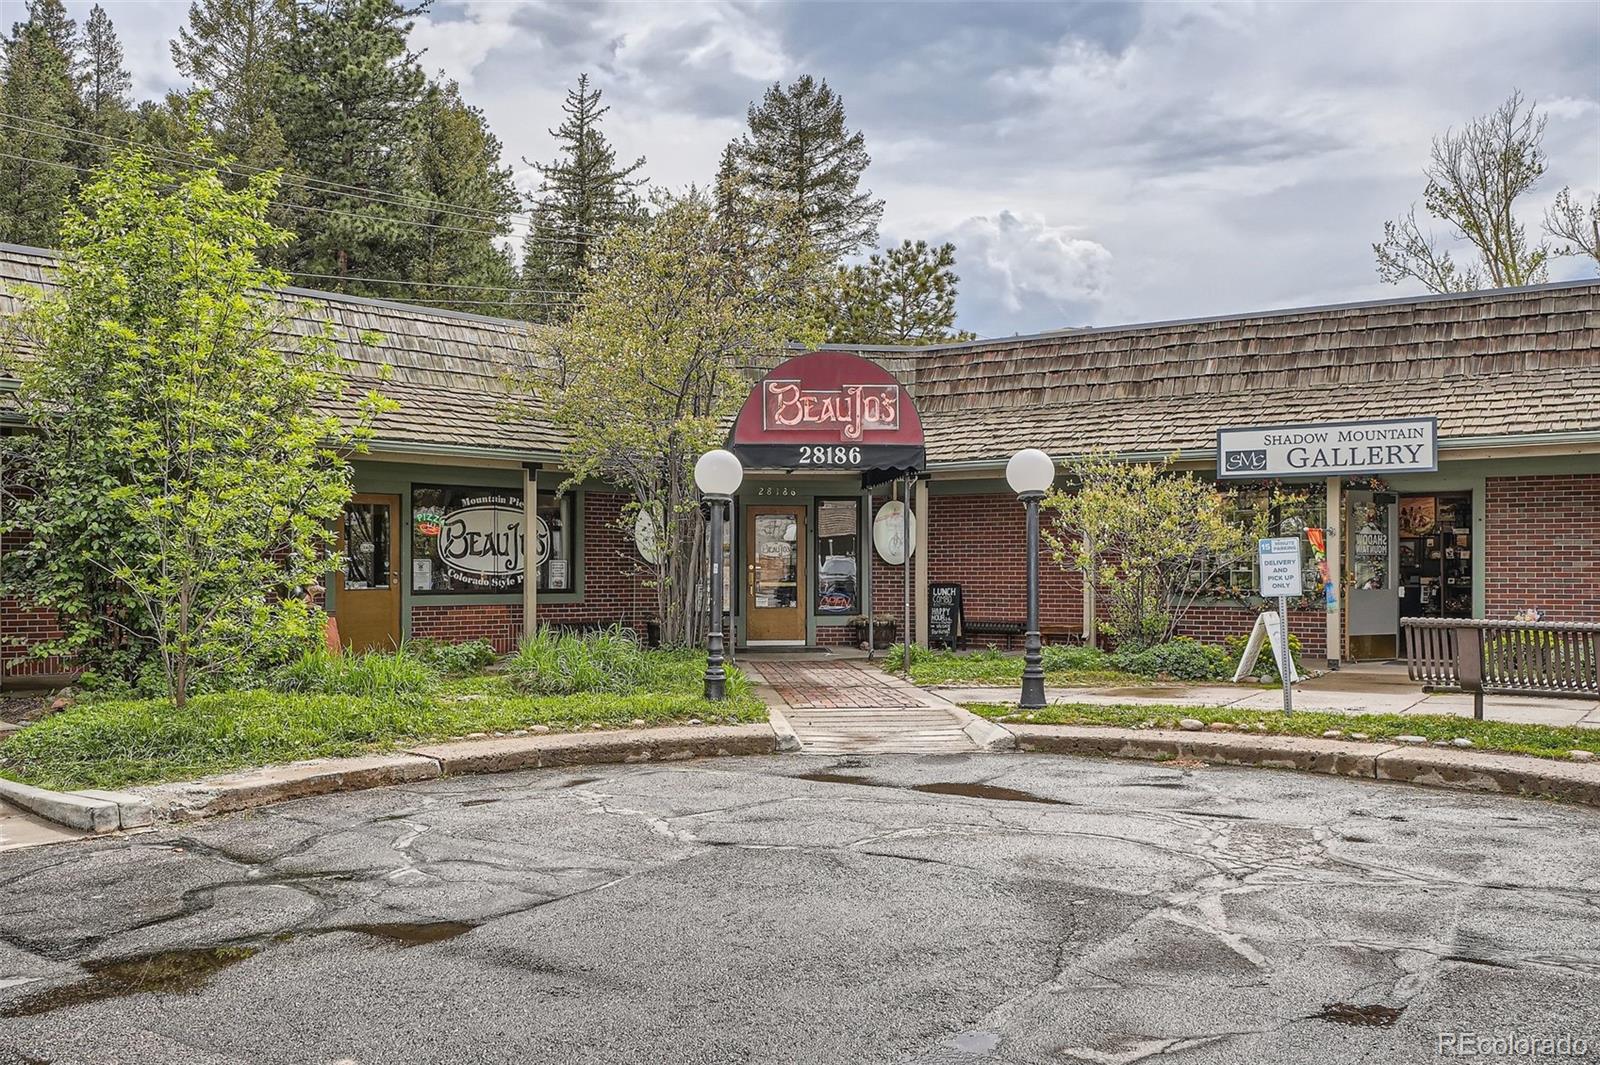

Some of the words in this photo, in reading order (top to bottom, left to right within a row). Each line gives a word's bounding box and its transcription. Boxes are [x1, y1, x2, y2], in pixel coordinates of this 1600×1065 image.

[1264, 433, 1328, 446] SHADOW
[1338, 428, 1425, 443] MOUNTAIN
[799, 446, 861, 465] 28186
[1226, 452, 1266, 470] SMG
[1287, 443, 1425, 469] GALLERY
[758, 487, 797, 496] 28186
[461, 495, 507, 507] Mountain
[416, 513, 447, 526] PIZZA
[1261, 543, 1270, 551] 15
[447, 569, 489, 586] Colorado
[491, 576, 516, 588] Style
[932, 587, 957, 596] LUNCH
